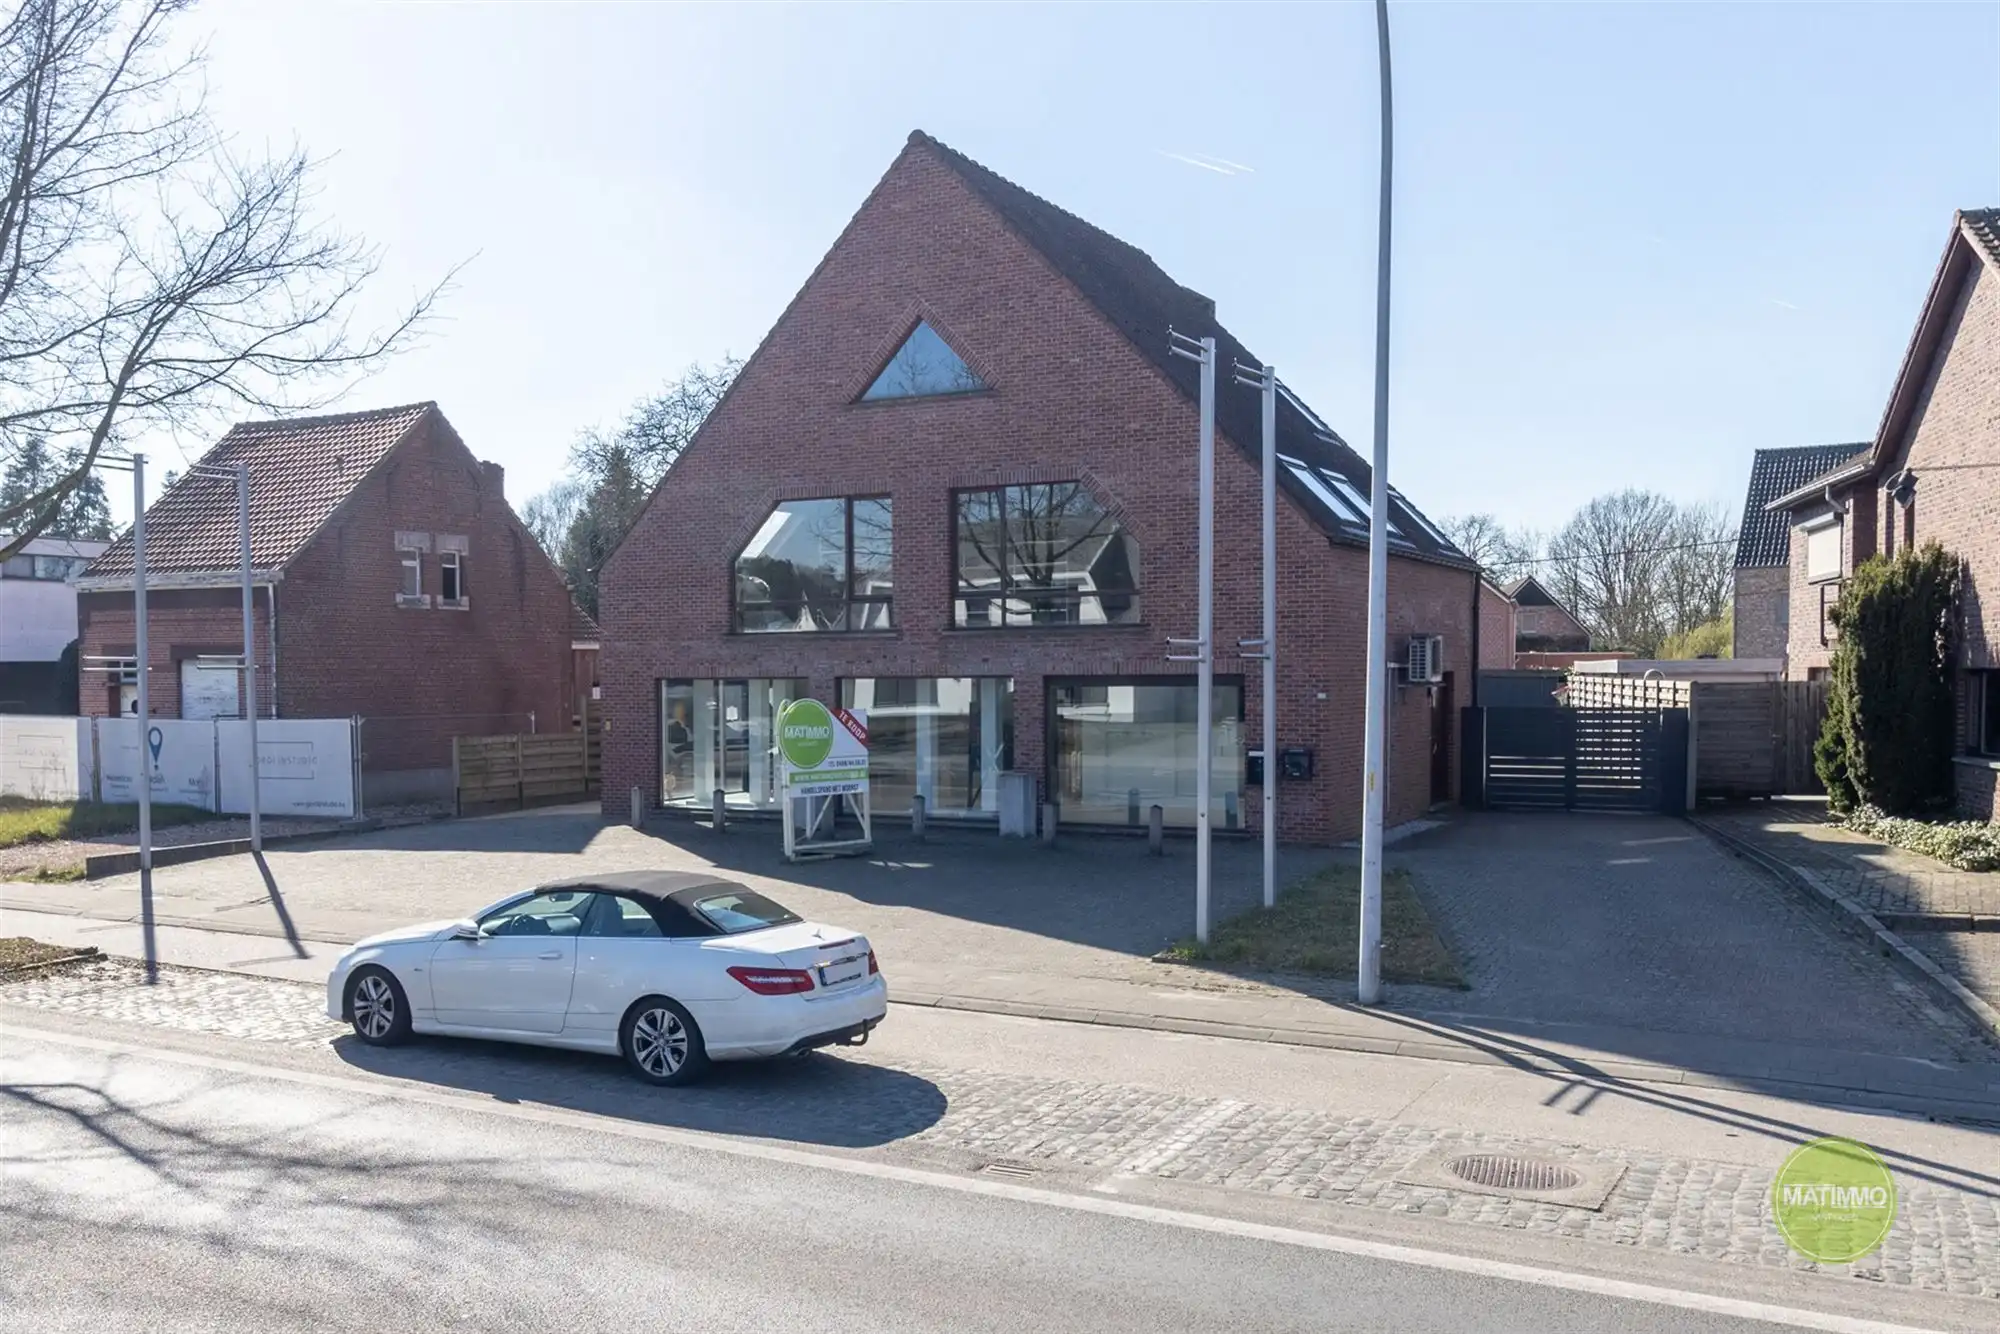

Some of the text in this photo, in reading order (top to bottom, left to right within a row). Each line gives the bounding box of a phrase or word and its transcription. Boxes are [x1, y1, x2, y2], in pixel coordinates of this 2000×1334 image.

[784, 726, 829, 739] MATIMMO
[839, 710, 866, 739] TE KOOP
